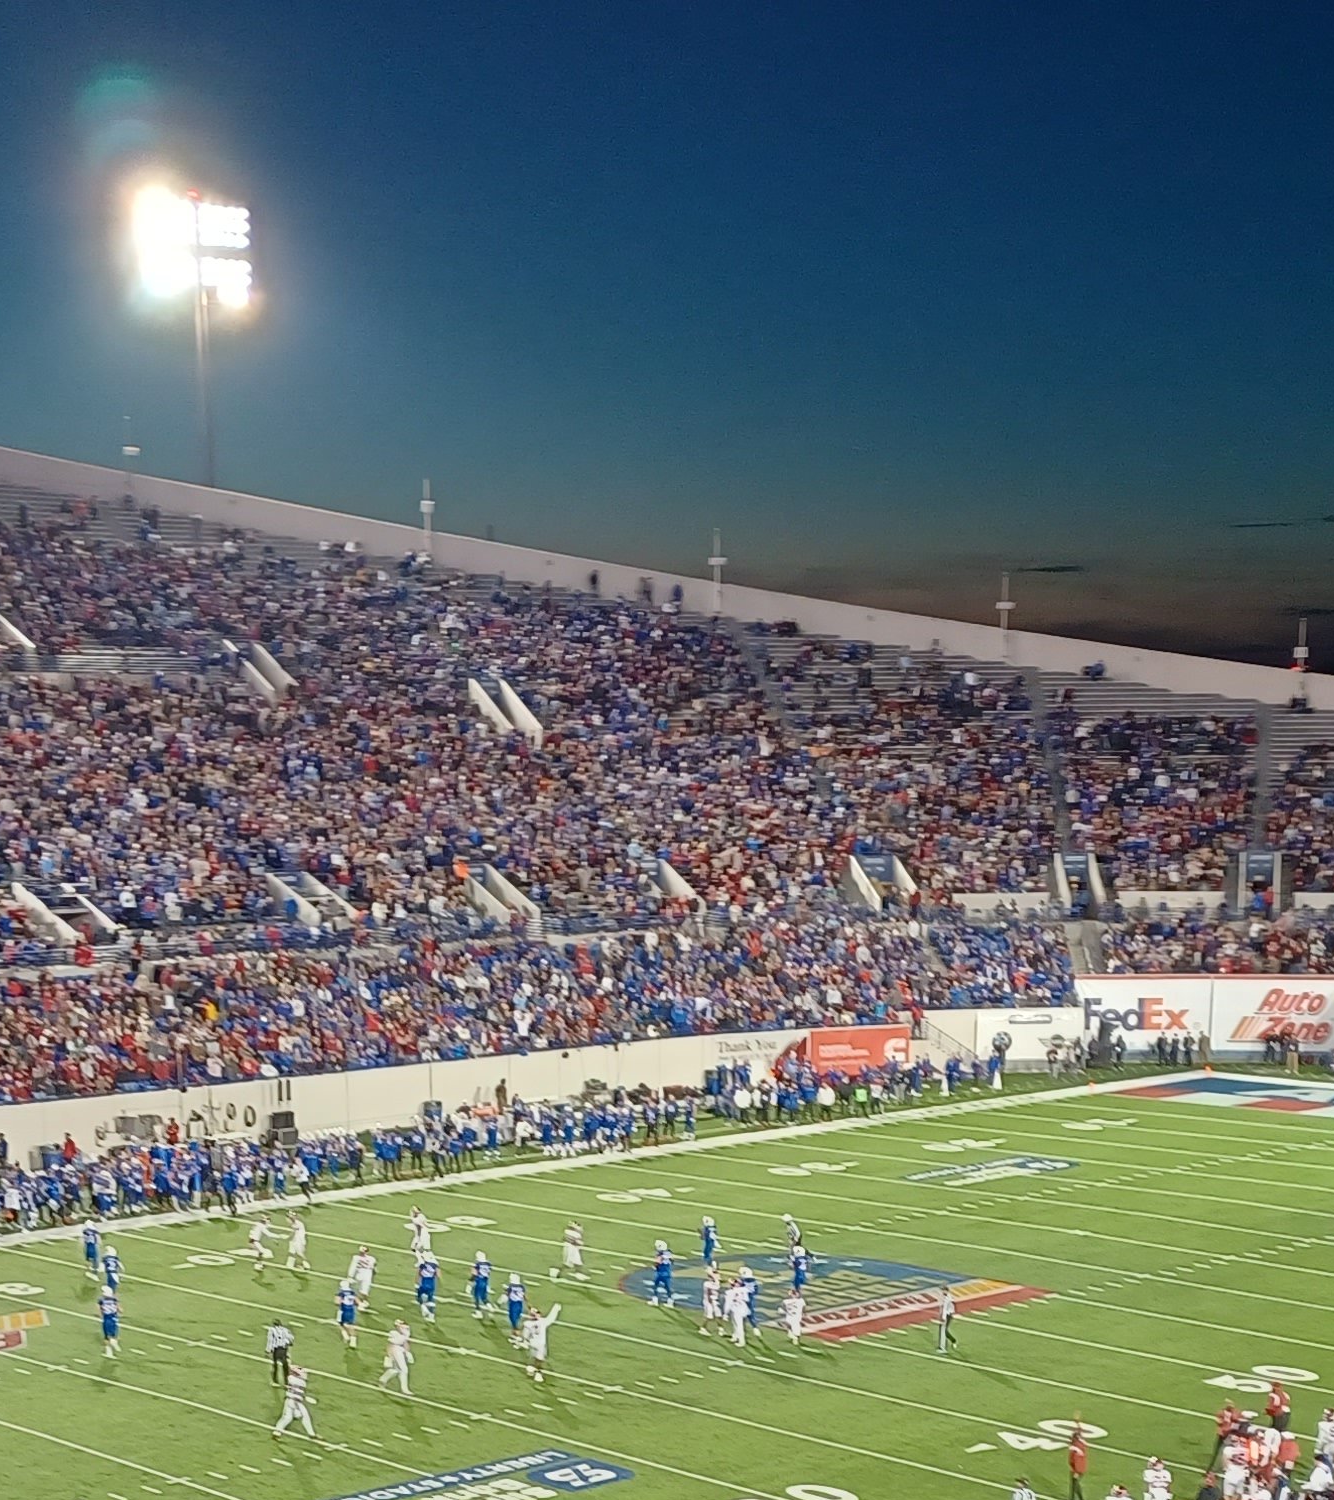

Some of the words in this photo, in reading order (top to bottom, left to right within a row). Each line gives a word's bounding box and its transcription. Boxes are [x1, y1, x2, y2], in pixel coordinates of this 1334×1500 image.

[1084, 997, 1190, 1031] FedEx
[1255, 987, 1328, 1015] Auto
[1257, 1016, 1332, 1043] Zone
[795, 1289, 938, 1330] AutoZon
[458, 1450, 568, 1482] LIBERTY
